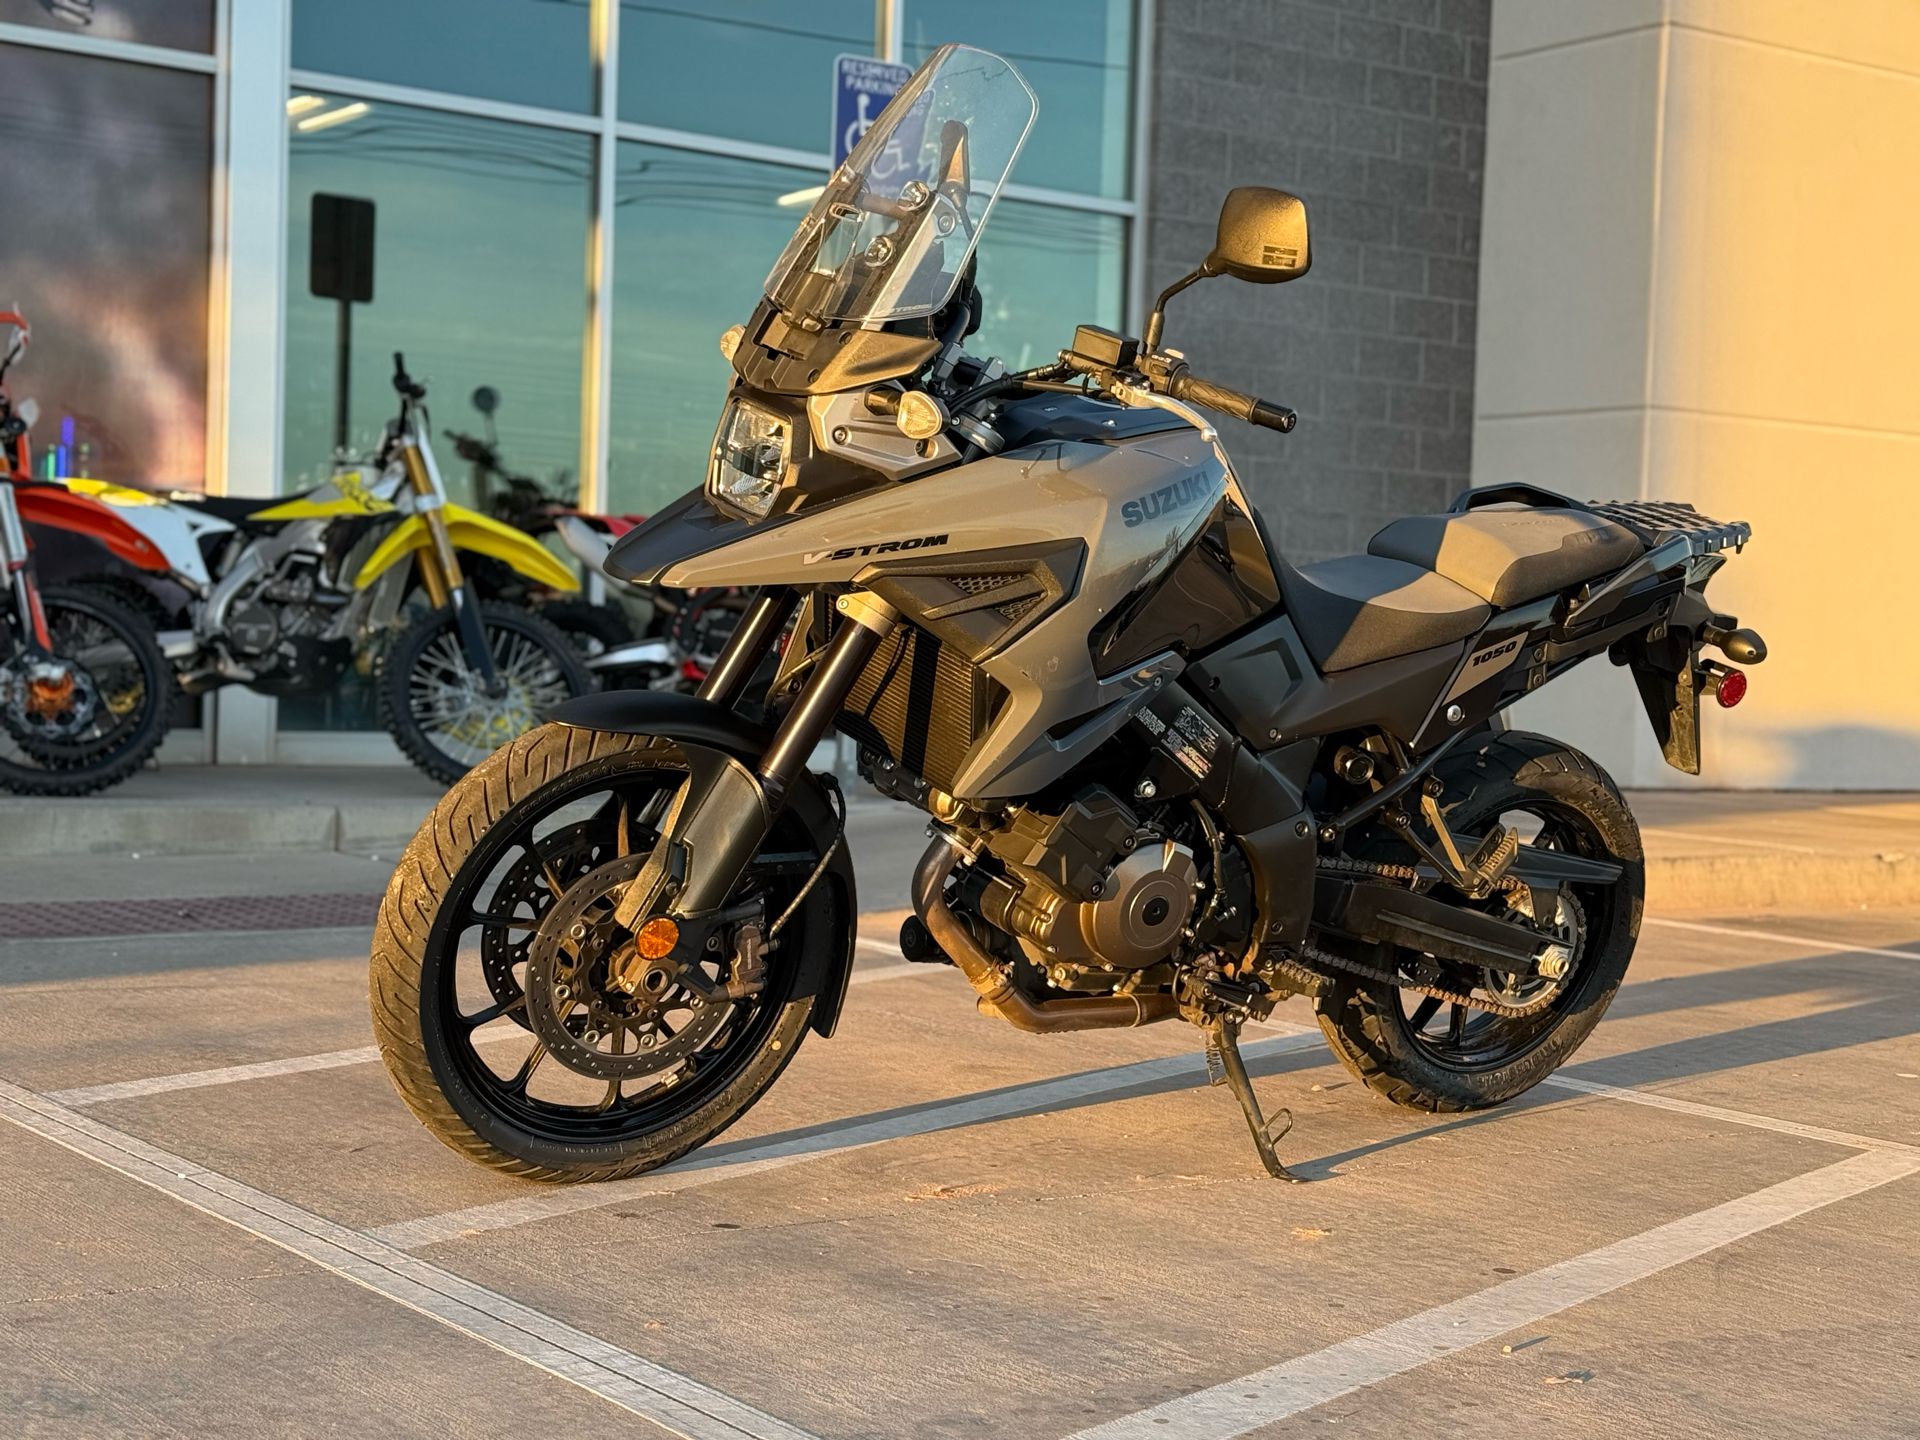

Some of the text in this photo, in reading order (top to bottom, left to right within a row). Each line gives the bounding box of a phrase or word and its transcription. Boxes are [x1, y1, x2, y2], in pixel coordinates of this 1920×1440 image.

[1121, 471, 1213, 528] SUZUKI
[803, 534, 949, 566] V-STROM
[1472, 641, 1518, 668] 1050
